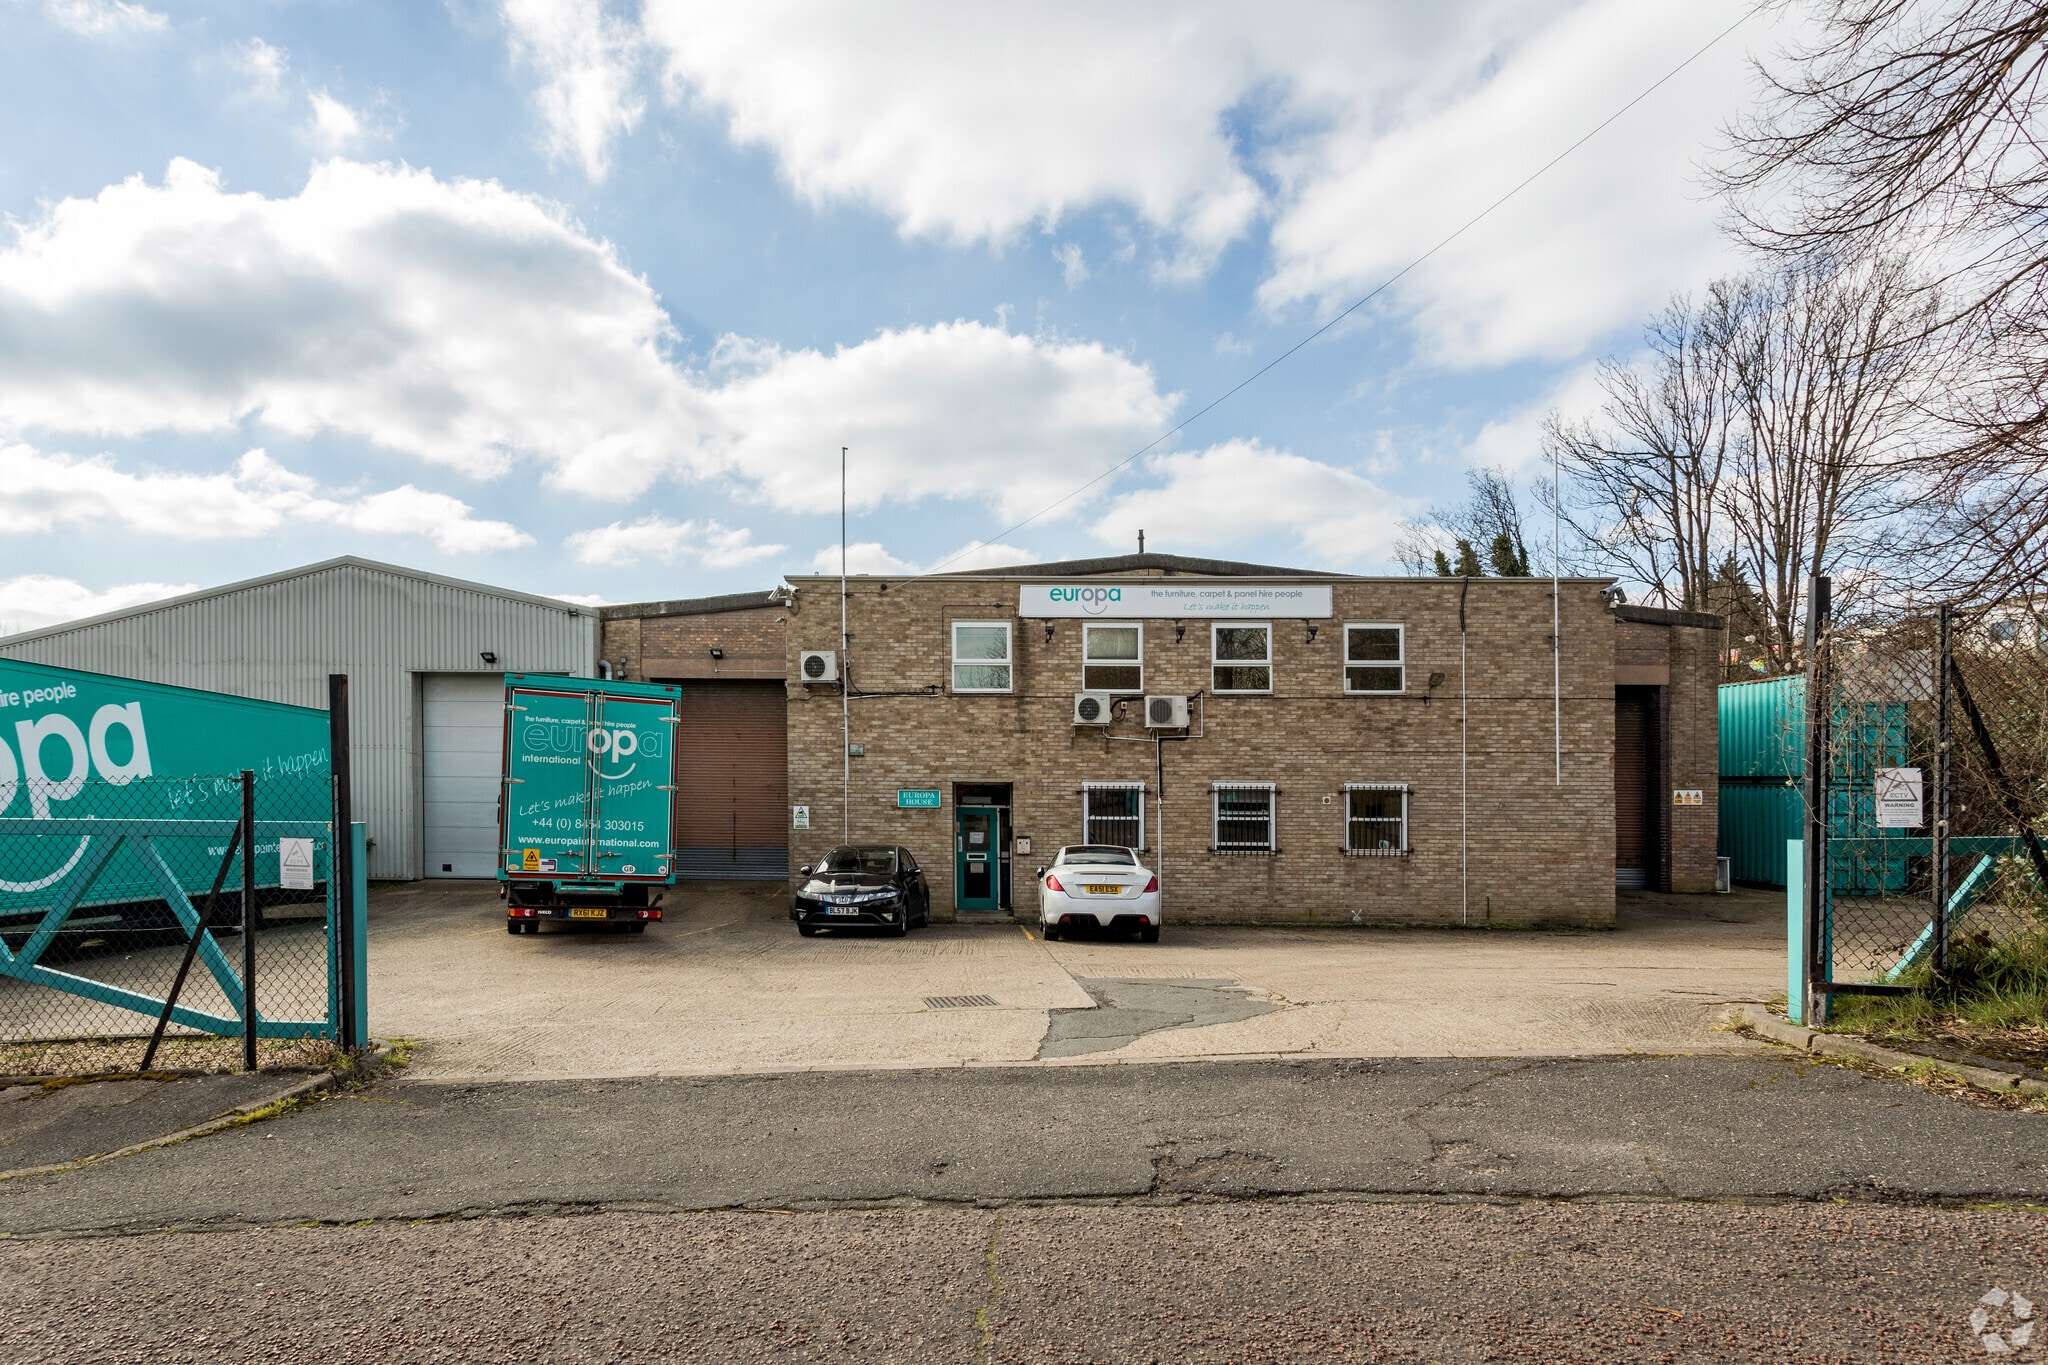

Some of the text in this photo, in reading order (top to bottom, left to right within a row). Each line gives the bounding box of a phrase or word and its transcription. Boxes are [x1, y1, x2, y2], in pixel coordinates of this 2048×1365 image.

[1049, 587, 1121, 606] europa
[1151, 590, 1303, 599] the furniture, carpet & panel hire people
[1206, 603, 1230, 611] make
[1231, 603, 1238, 611] it
[1241, 603, 1270, 613] happen
[23, 681, 77, 708] people
[523, 723, 663, 763] europa
[262, 756, 274, 781] it
[277, 747, 329, 780] happen
[522, 753, 581, 765] international
[0, 701, 153, 837] pa
[519, 780, 653, 816] Let's make it happen
[532, 818, 553, 829] +44
[556, 817, 572, 830] (0)
[604, 820, 645, 831] 303015
[623, 865, 634, 873] GB
[590, 909, 605, 917] KJZ
